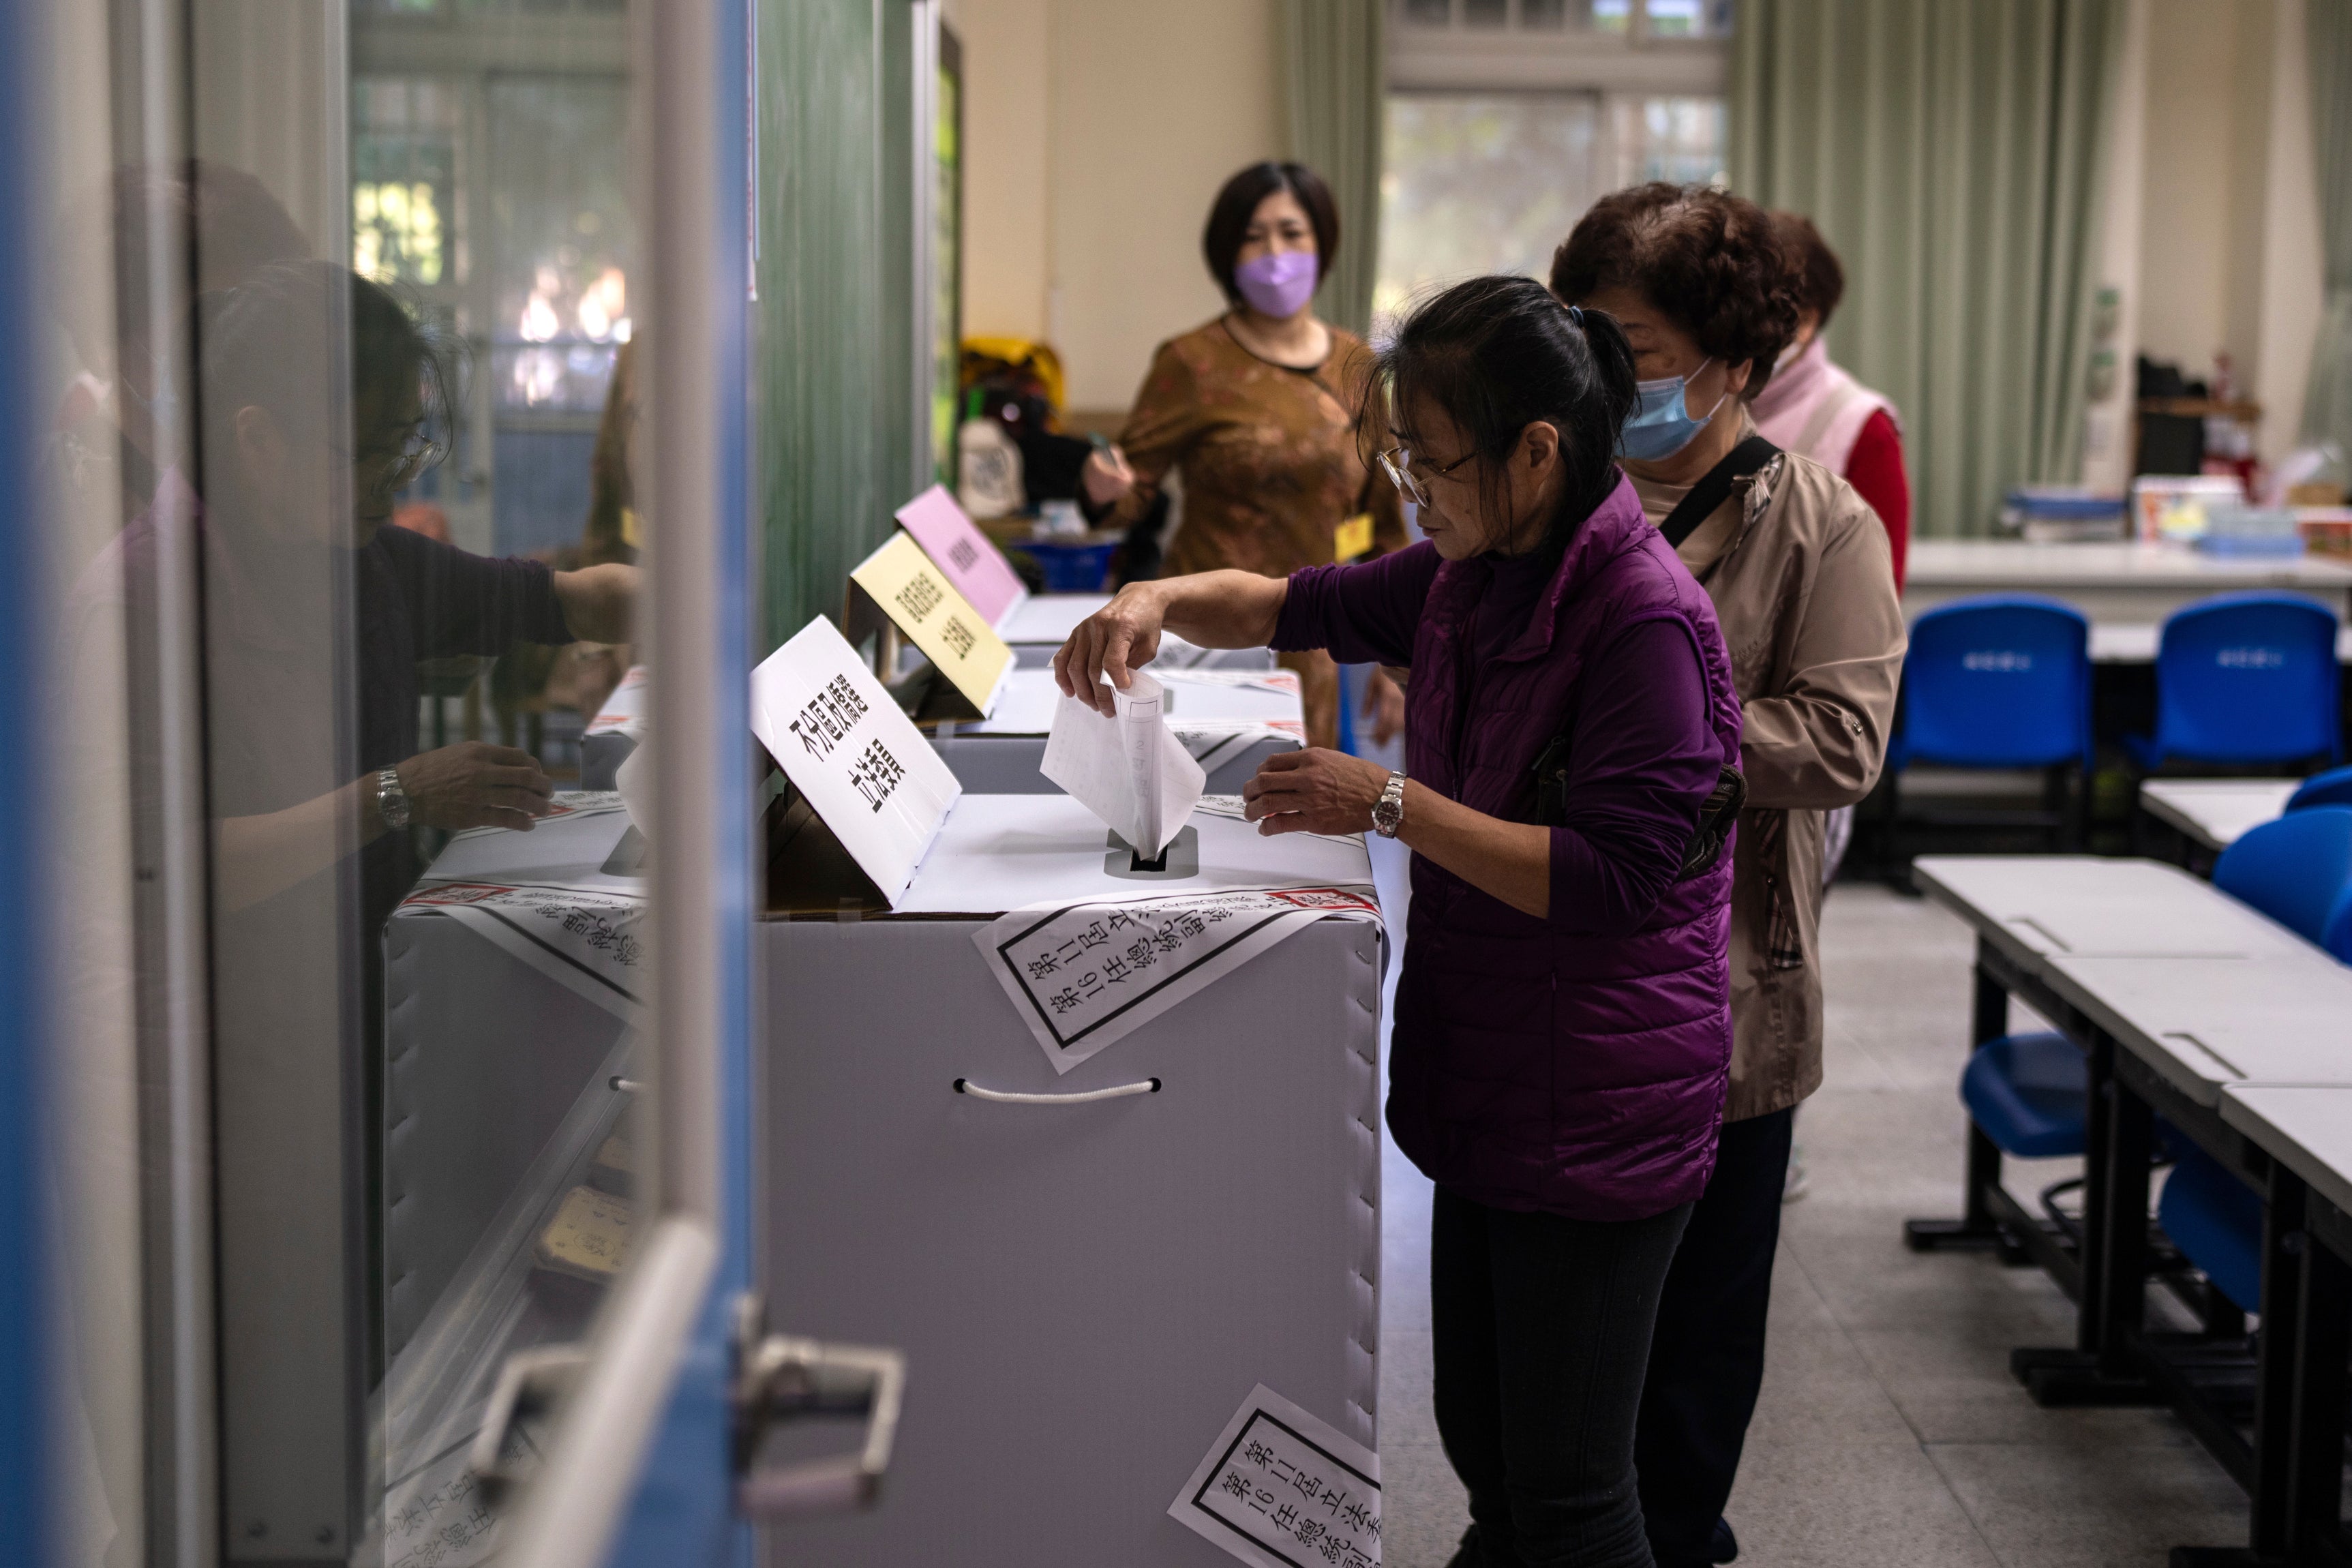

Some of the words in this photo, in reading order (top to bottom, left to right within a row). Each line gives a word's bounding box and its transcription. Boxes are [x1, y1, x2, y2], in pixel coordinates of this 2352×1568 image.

[789, 673, 869, 762] 不分區及僑選
[847, 738, 906, 814] 立法委員
